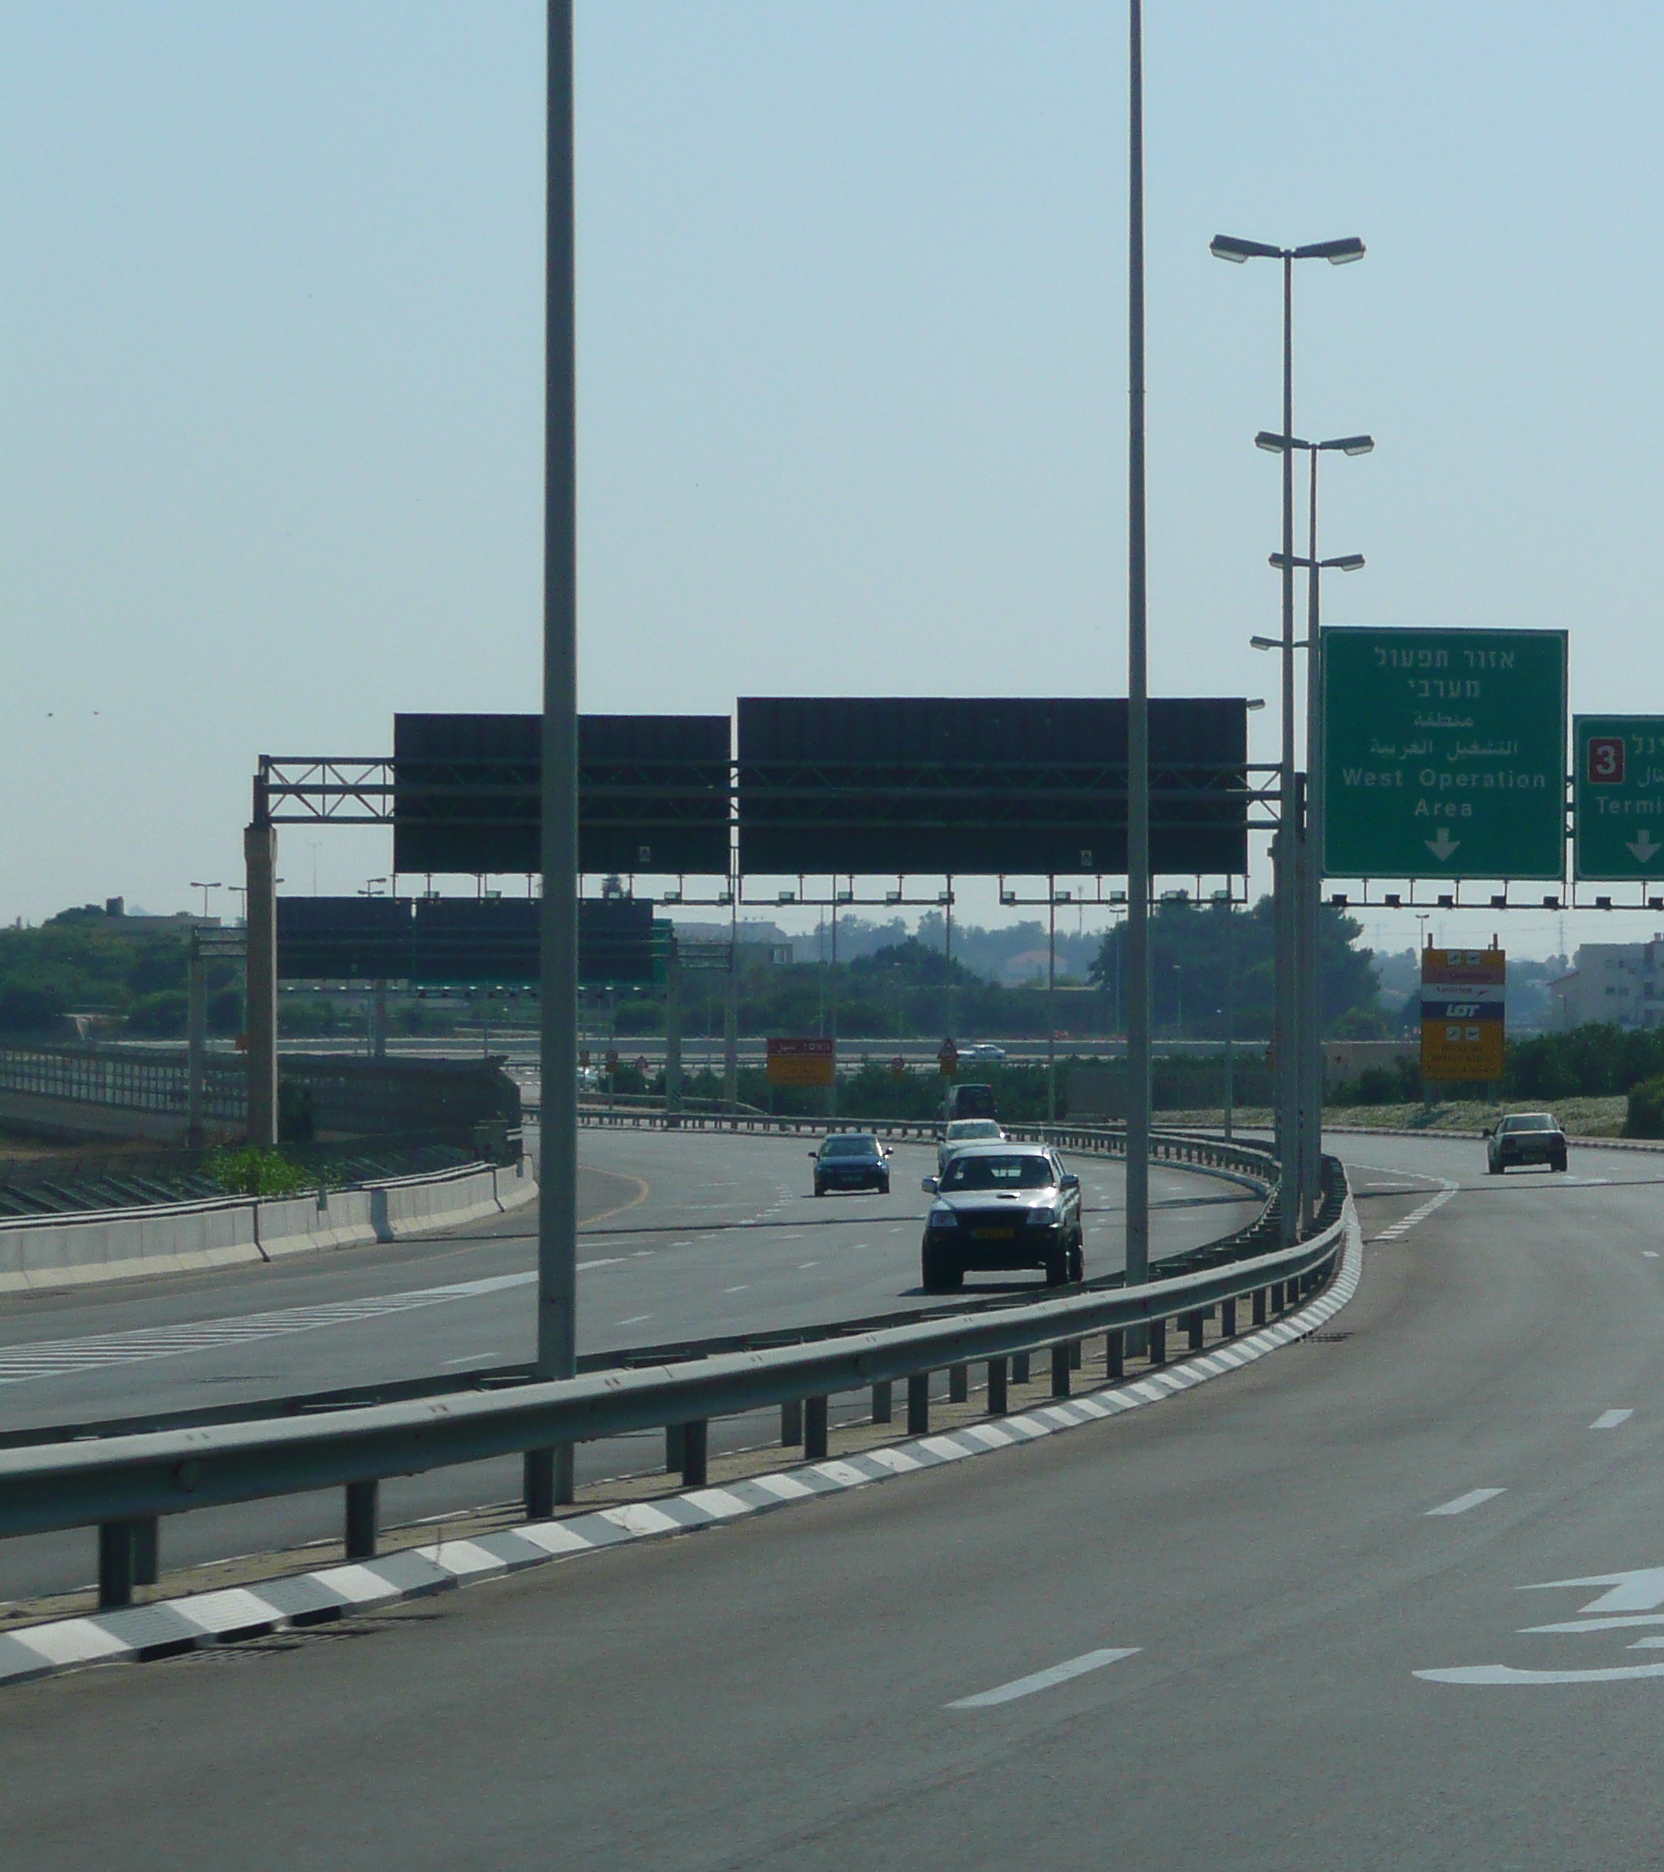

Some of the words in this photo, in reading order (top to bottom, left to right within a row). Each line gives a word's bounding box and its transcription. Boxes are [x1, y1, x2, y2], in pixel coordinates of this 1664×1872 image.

[1374, 646, 1449, 668] תפעול
[1463, 649, 1515, 669] אזור
[1407, 679, 1481, 698] מערבי
[1413, 710, 1475, 728] منطقة
[1446, 739, 1518, 762] التشغيل
[1595, 745, 1617, 775] 3
[1341, 768, 1404, 787] West
[1419, 768, 1546, 790] Operation
[1414, 798, 1473, 817] Area
[1445, 1003, 1480, 1018] LOT
